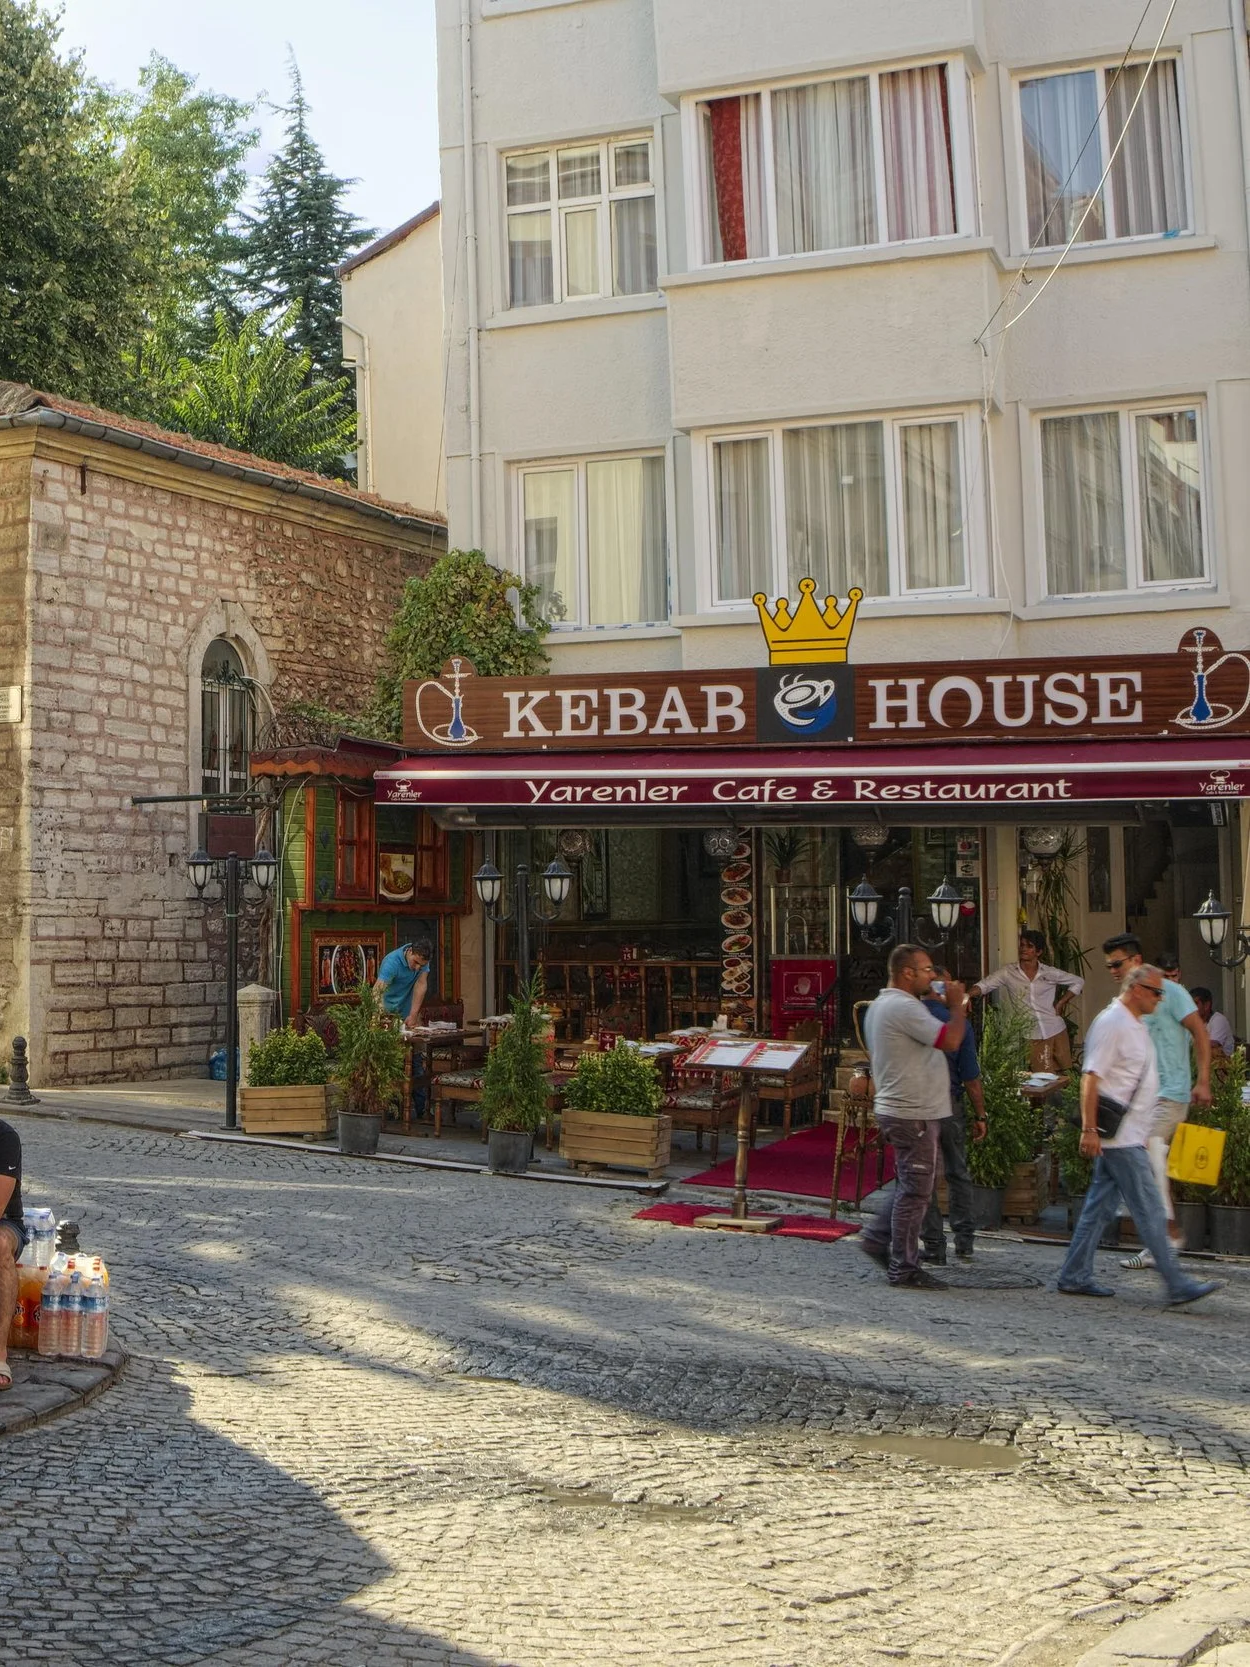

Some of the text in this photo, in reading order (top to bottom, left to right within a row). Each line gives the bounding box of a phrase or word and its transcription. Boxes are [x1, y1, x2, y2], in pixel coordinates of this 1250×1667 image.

[503, 671, 1143, 738] KEBAB HOUSE
[387, 789, 422, 799] Yarenler
[526, 778, 1072, 804] Yarenler Cafe & Restaurant
[1199, 781, 1245, 792] Yarenler
